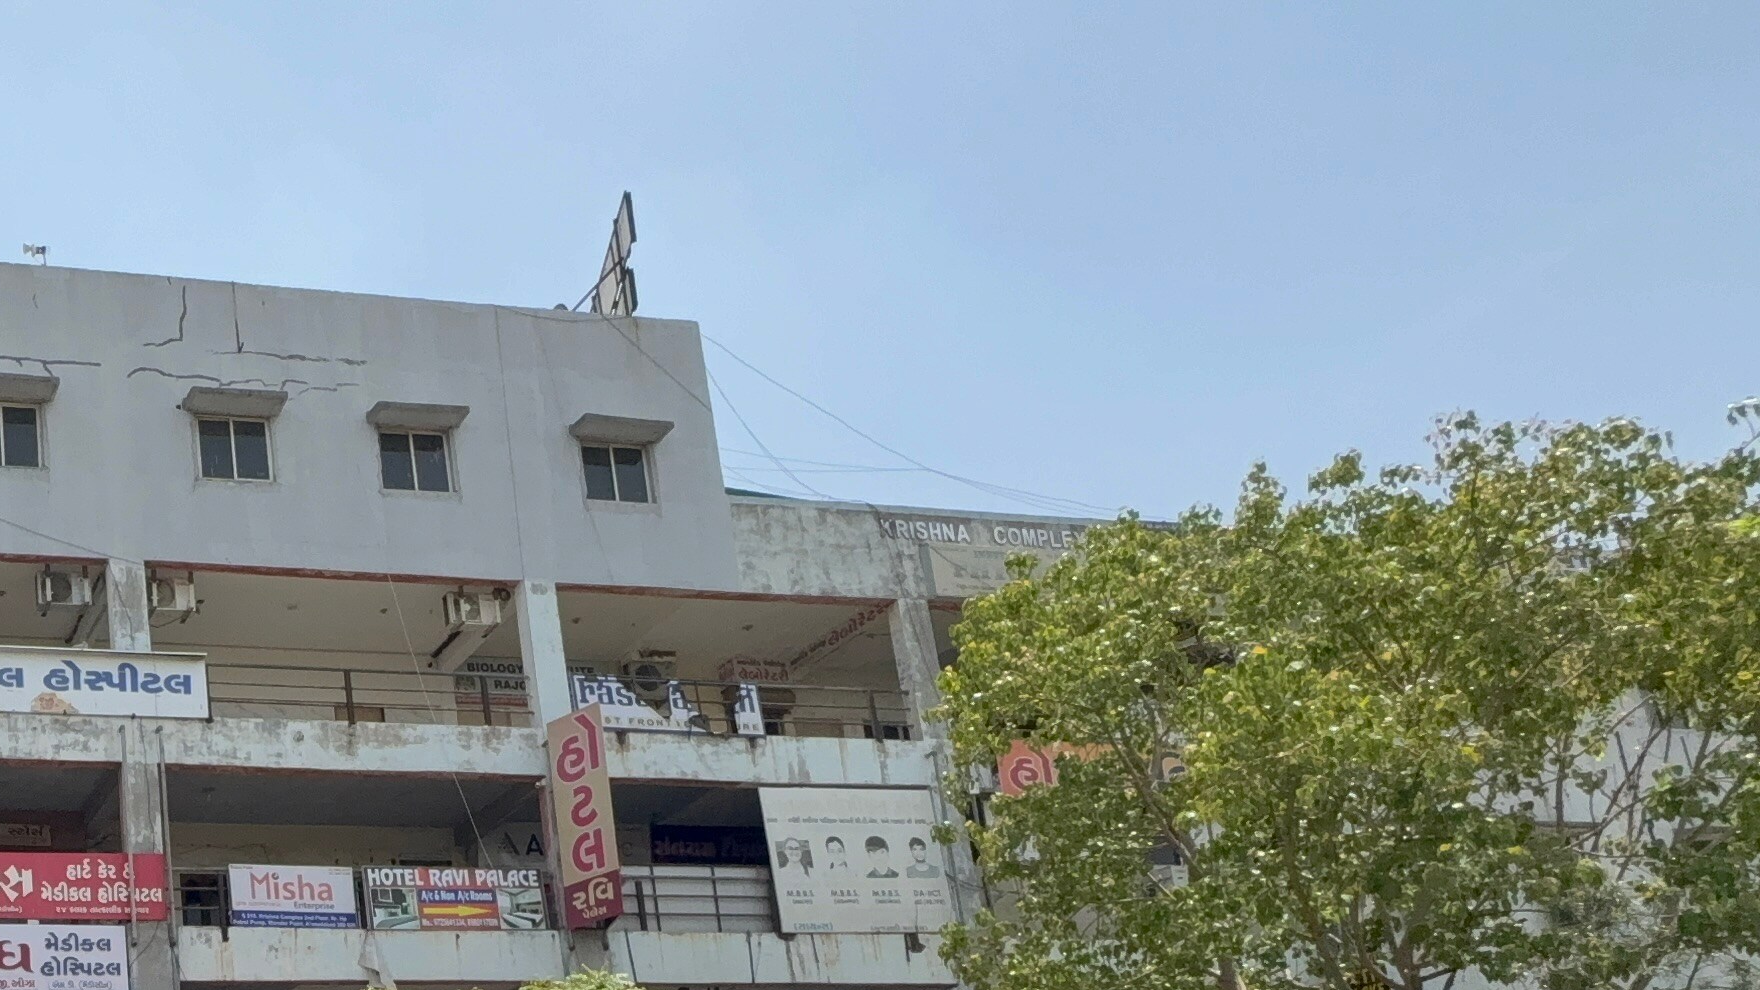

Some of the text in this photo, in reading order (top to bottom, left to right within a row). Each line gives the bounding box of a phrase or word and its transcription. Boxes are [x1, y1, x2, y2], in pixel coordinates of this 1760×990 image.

[880, 518, 971, 543] KRISHNA
[467, 662, 524, 674] BIOLOGY
[66, 858, 116, 880] હાર્ટ કેર
[367, 868, 424, 886] HOTEL
[429, 868, 469, 887] RAVI
[475, 869, 539, 887] PALACE
[40, 881, 91, 902] મેડીકલ
[249, 871, 334, 901] Misha
[572, 877, 614, 911] રવિ
[294, 901, 335, 911] Enterprise
[44, 932, 112, 952] મેડીકલ
[40, 956, 122, 977] હોસ્પિટલ
